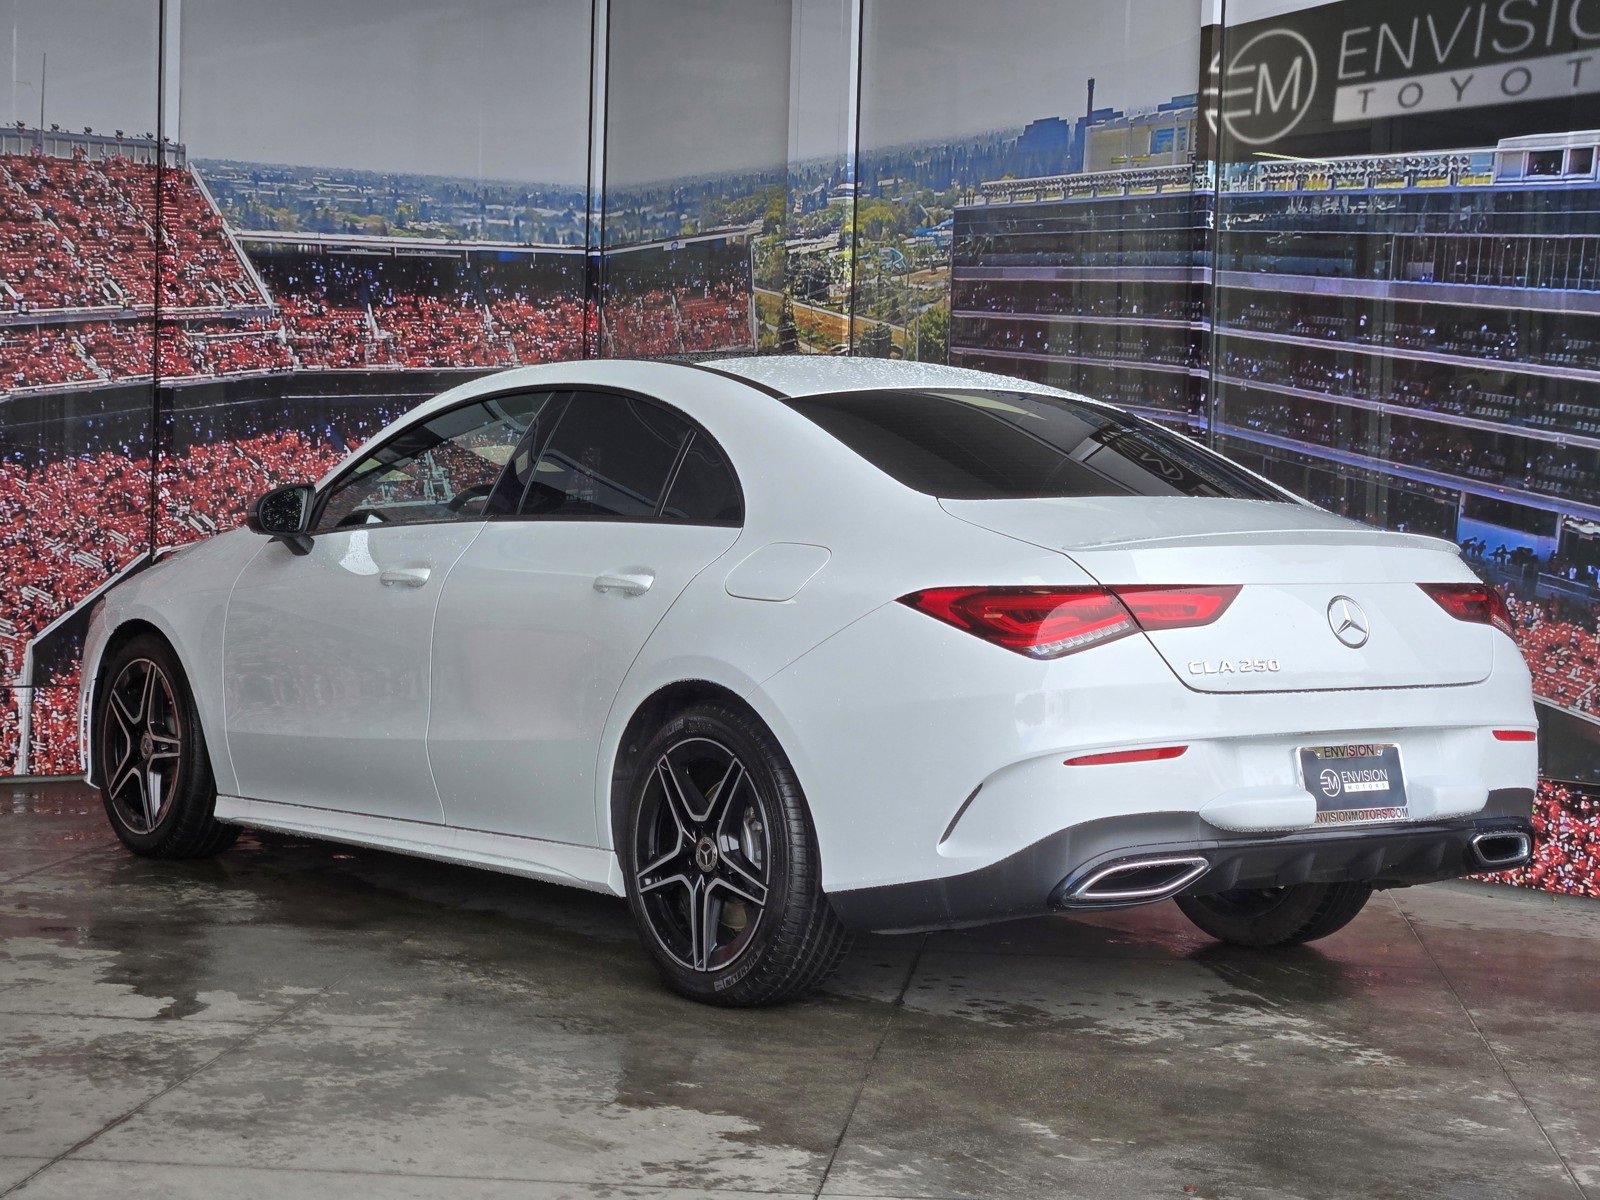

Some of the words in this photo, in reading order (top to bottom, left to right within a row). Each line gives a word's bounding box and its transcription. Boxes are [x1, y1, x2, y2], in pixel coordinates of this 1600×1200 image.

[1358, 57, 1593, 114] TOYOT
[1188, 660, 1235, 674] CLA
[1239, 658, 1280, 673] 250
[1324, 744, 1375, 758] ENVISION
[1341, 769, 1388, 783] ENVISION
[1315, 807, 1410, 823] NVISIONMOTORS.COM
